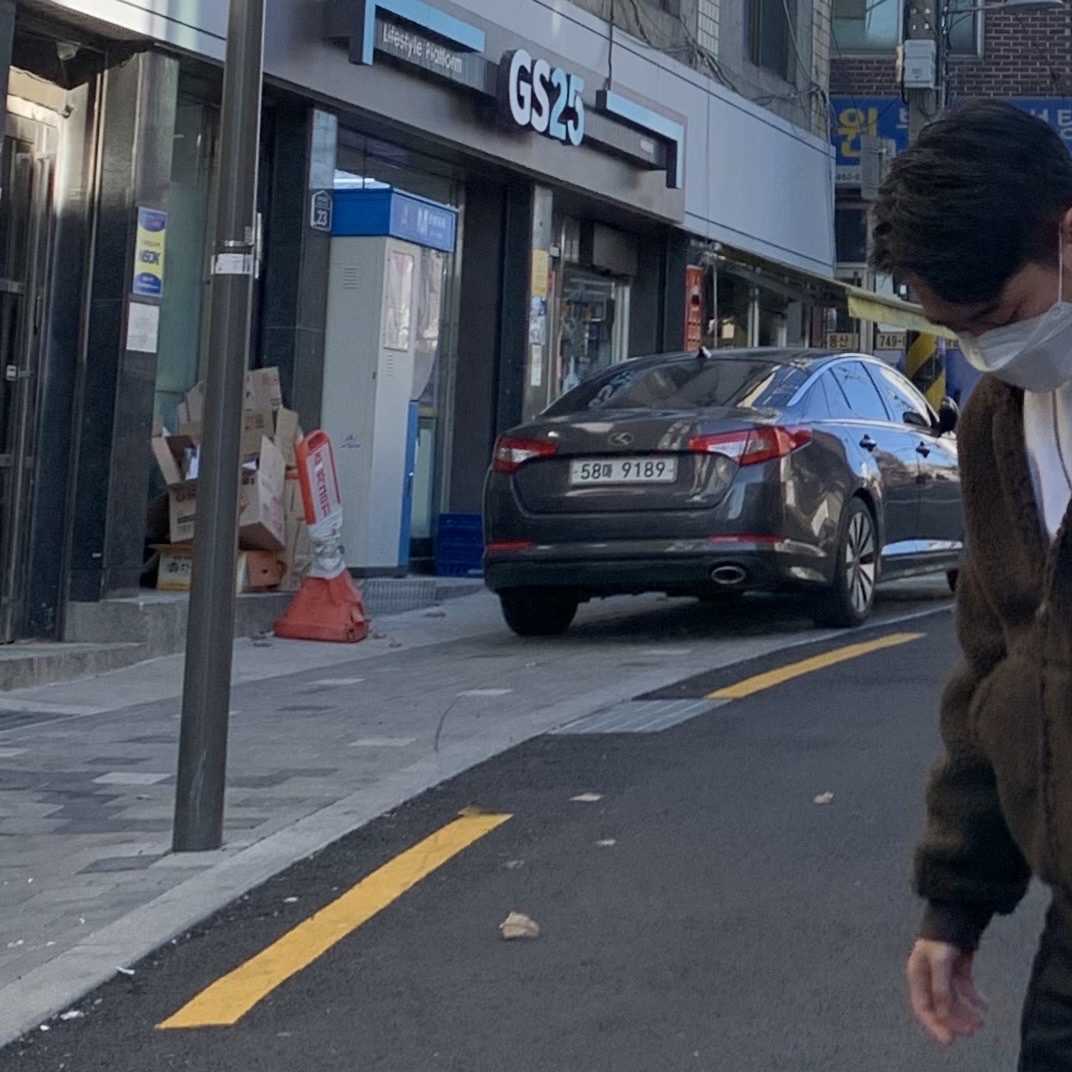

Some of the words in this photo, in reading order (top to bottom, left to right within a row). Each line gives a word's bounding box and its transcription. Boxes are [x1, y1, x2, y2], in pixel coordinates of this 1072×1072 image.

[382, 24, 422, 58] Lifestyle
[425, 41, 463, 74] Platform
[509, 48, 585, 146] GS25
[316, 209, 328, 226] 23
[621, 462, 666, 478] 9189
